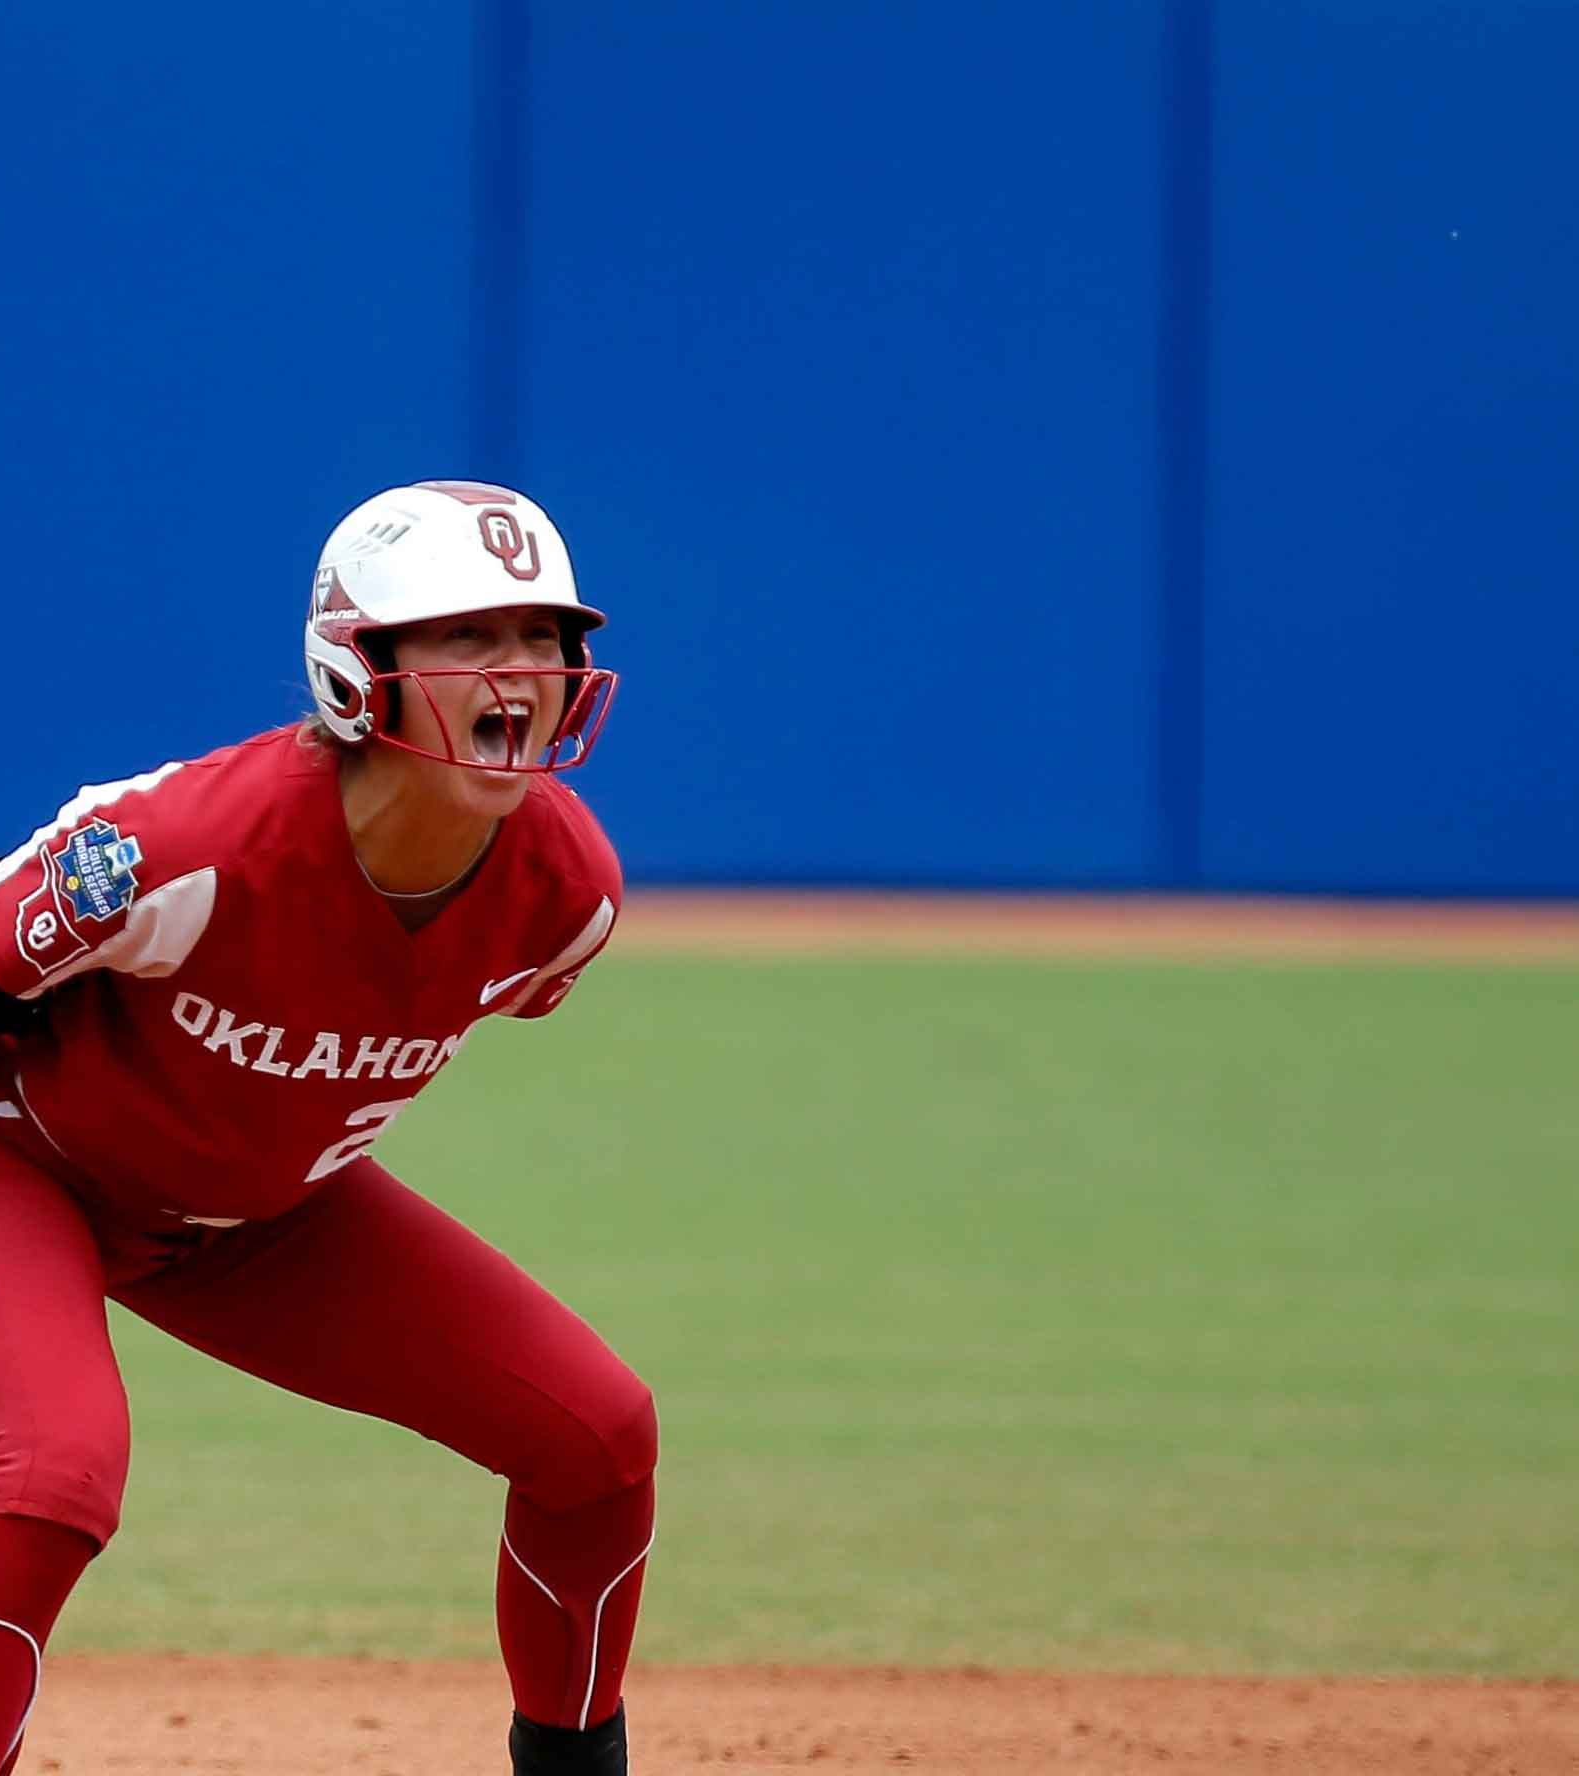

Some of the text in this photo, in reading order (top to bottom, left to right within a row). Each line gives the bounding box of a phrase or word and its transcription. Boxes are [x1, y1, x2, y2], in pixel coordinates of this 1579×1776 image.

[73, 833, 92, 874] WORLD
[84, 873, 112, 914] SERIES
[88, 845, 114, 893] COLLEGE
